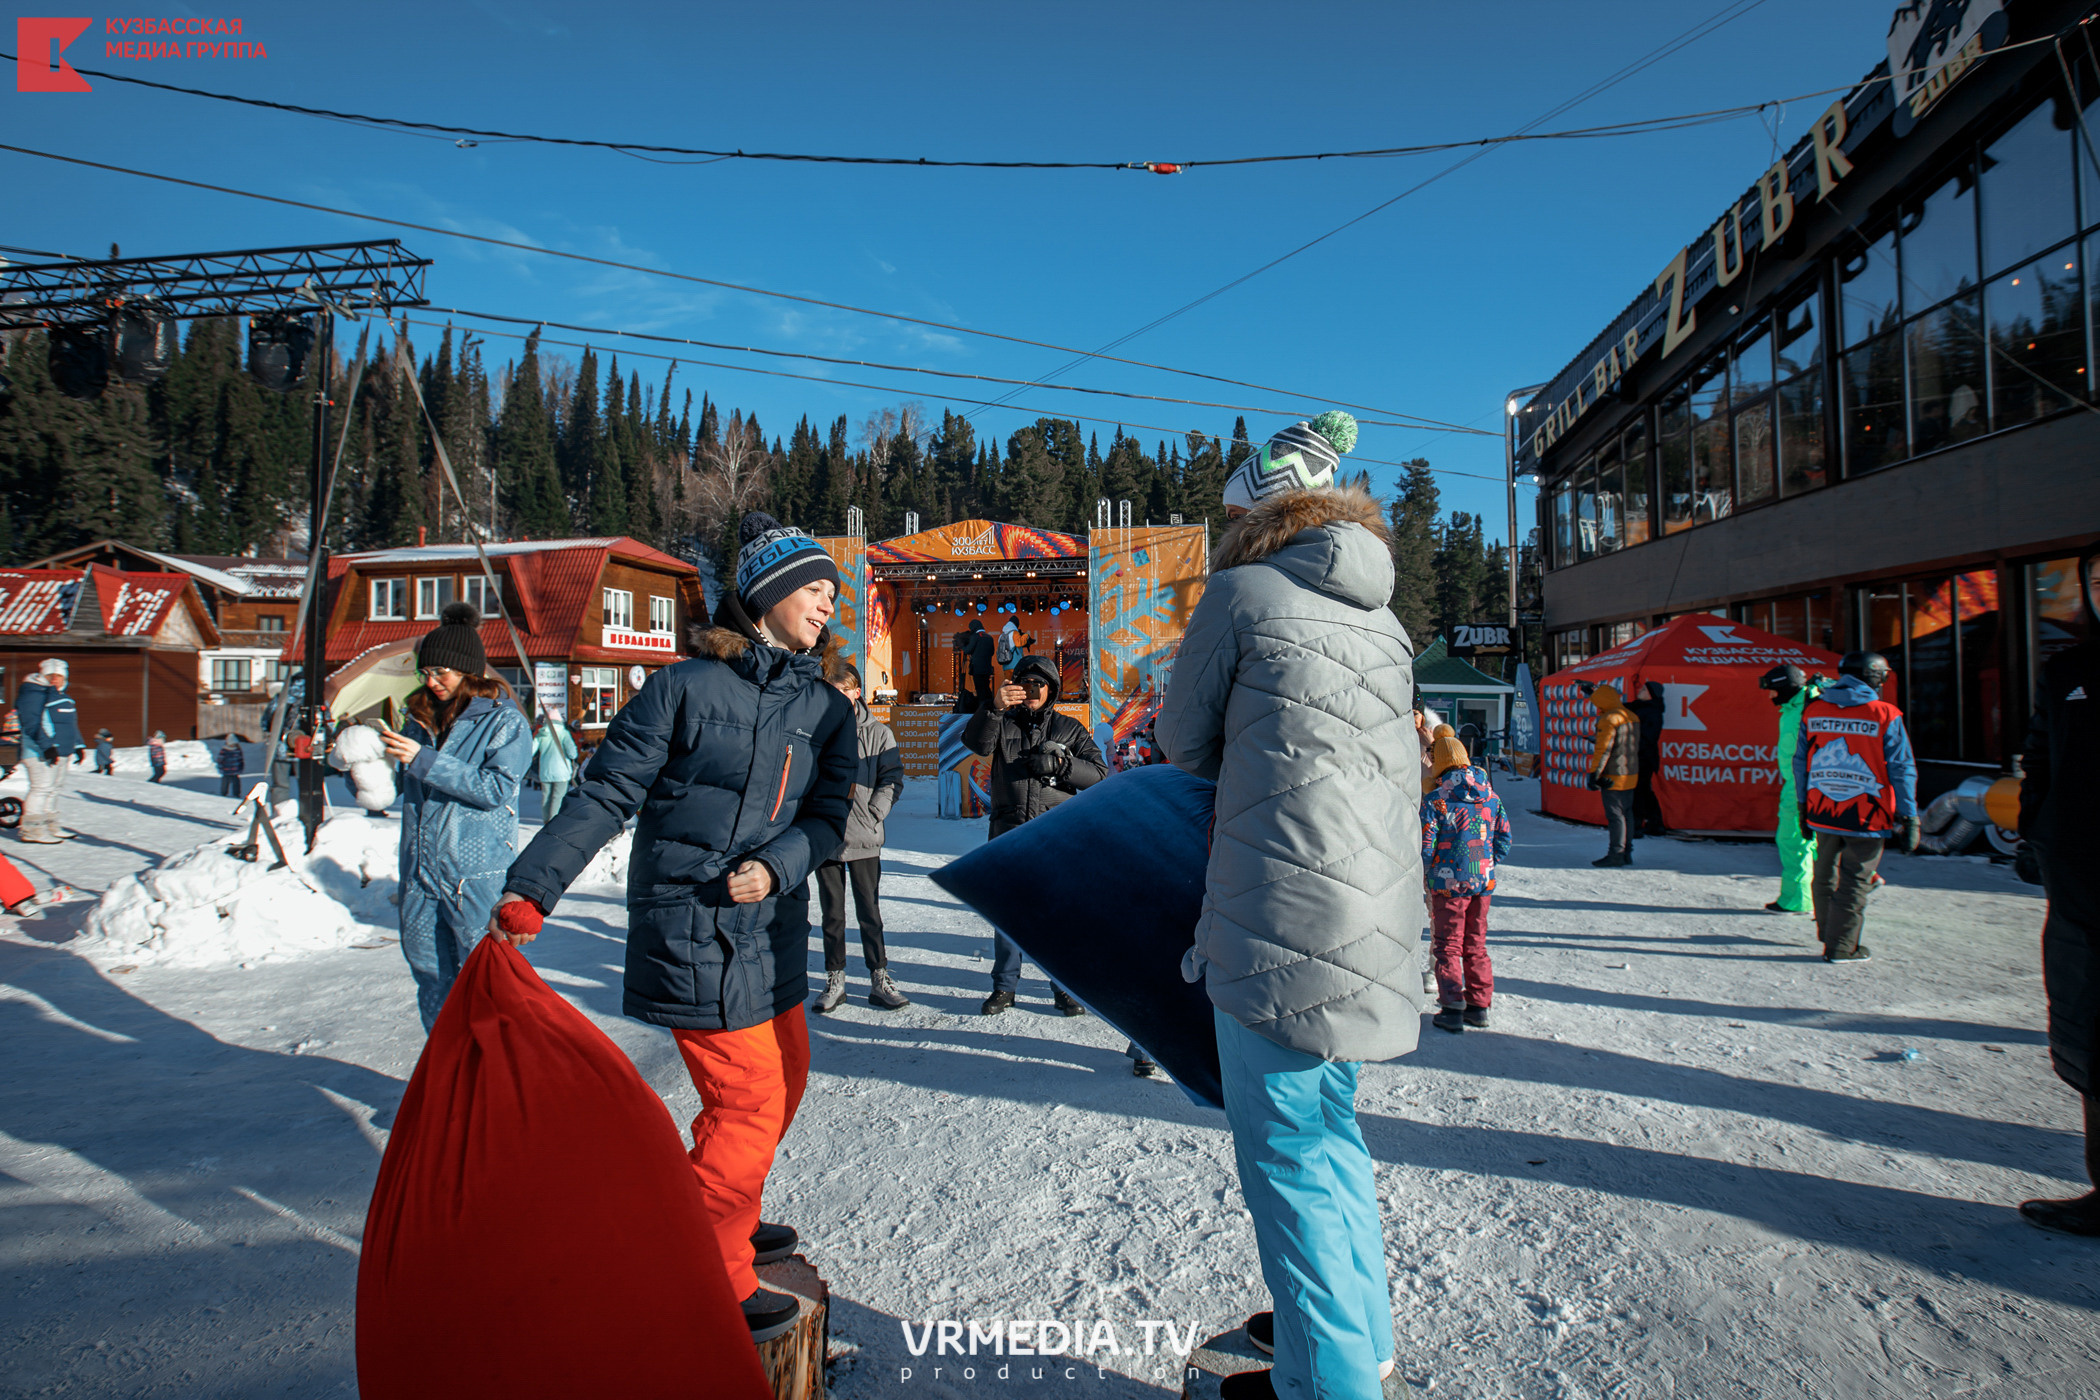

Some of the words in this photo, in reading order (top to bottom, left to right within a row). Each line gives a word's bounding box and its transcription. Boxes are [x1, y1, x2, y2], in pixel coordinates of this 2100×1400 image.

[1912, 32, 1985, 119] ZUBR
[1534, 385, 1589, 458] GRILL
[1594, 328, 1639, 397] BAR
[1655, 100, 1854, 360] ZUBR
[952, 536, 972, 546] 300
[951, 545, 997, 556] КУЗБАСС
[738, 538, 816, 590] OEGLIS
[610, 633, 672, 648] НЕВАЛЯШКА
[1453, 625, 1511, 647] ZUBR
[1685, 647, 1804, 655] КУЗБАССКАЯ
[1682, 656, 1752, 664] МЕДИА
[1751, 656, 1826, 664] ГРУППА
[1811, 719, 1877, 734] ИНСТРУКТОР
[1662, 742, 1780, 762] КУЗБАССКА
[1664, 765, 1735, 785] МЕДИА
[1826, 770, 1873, 783] COUNTRY
